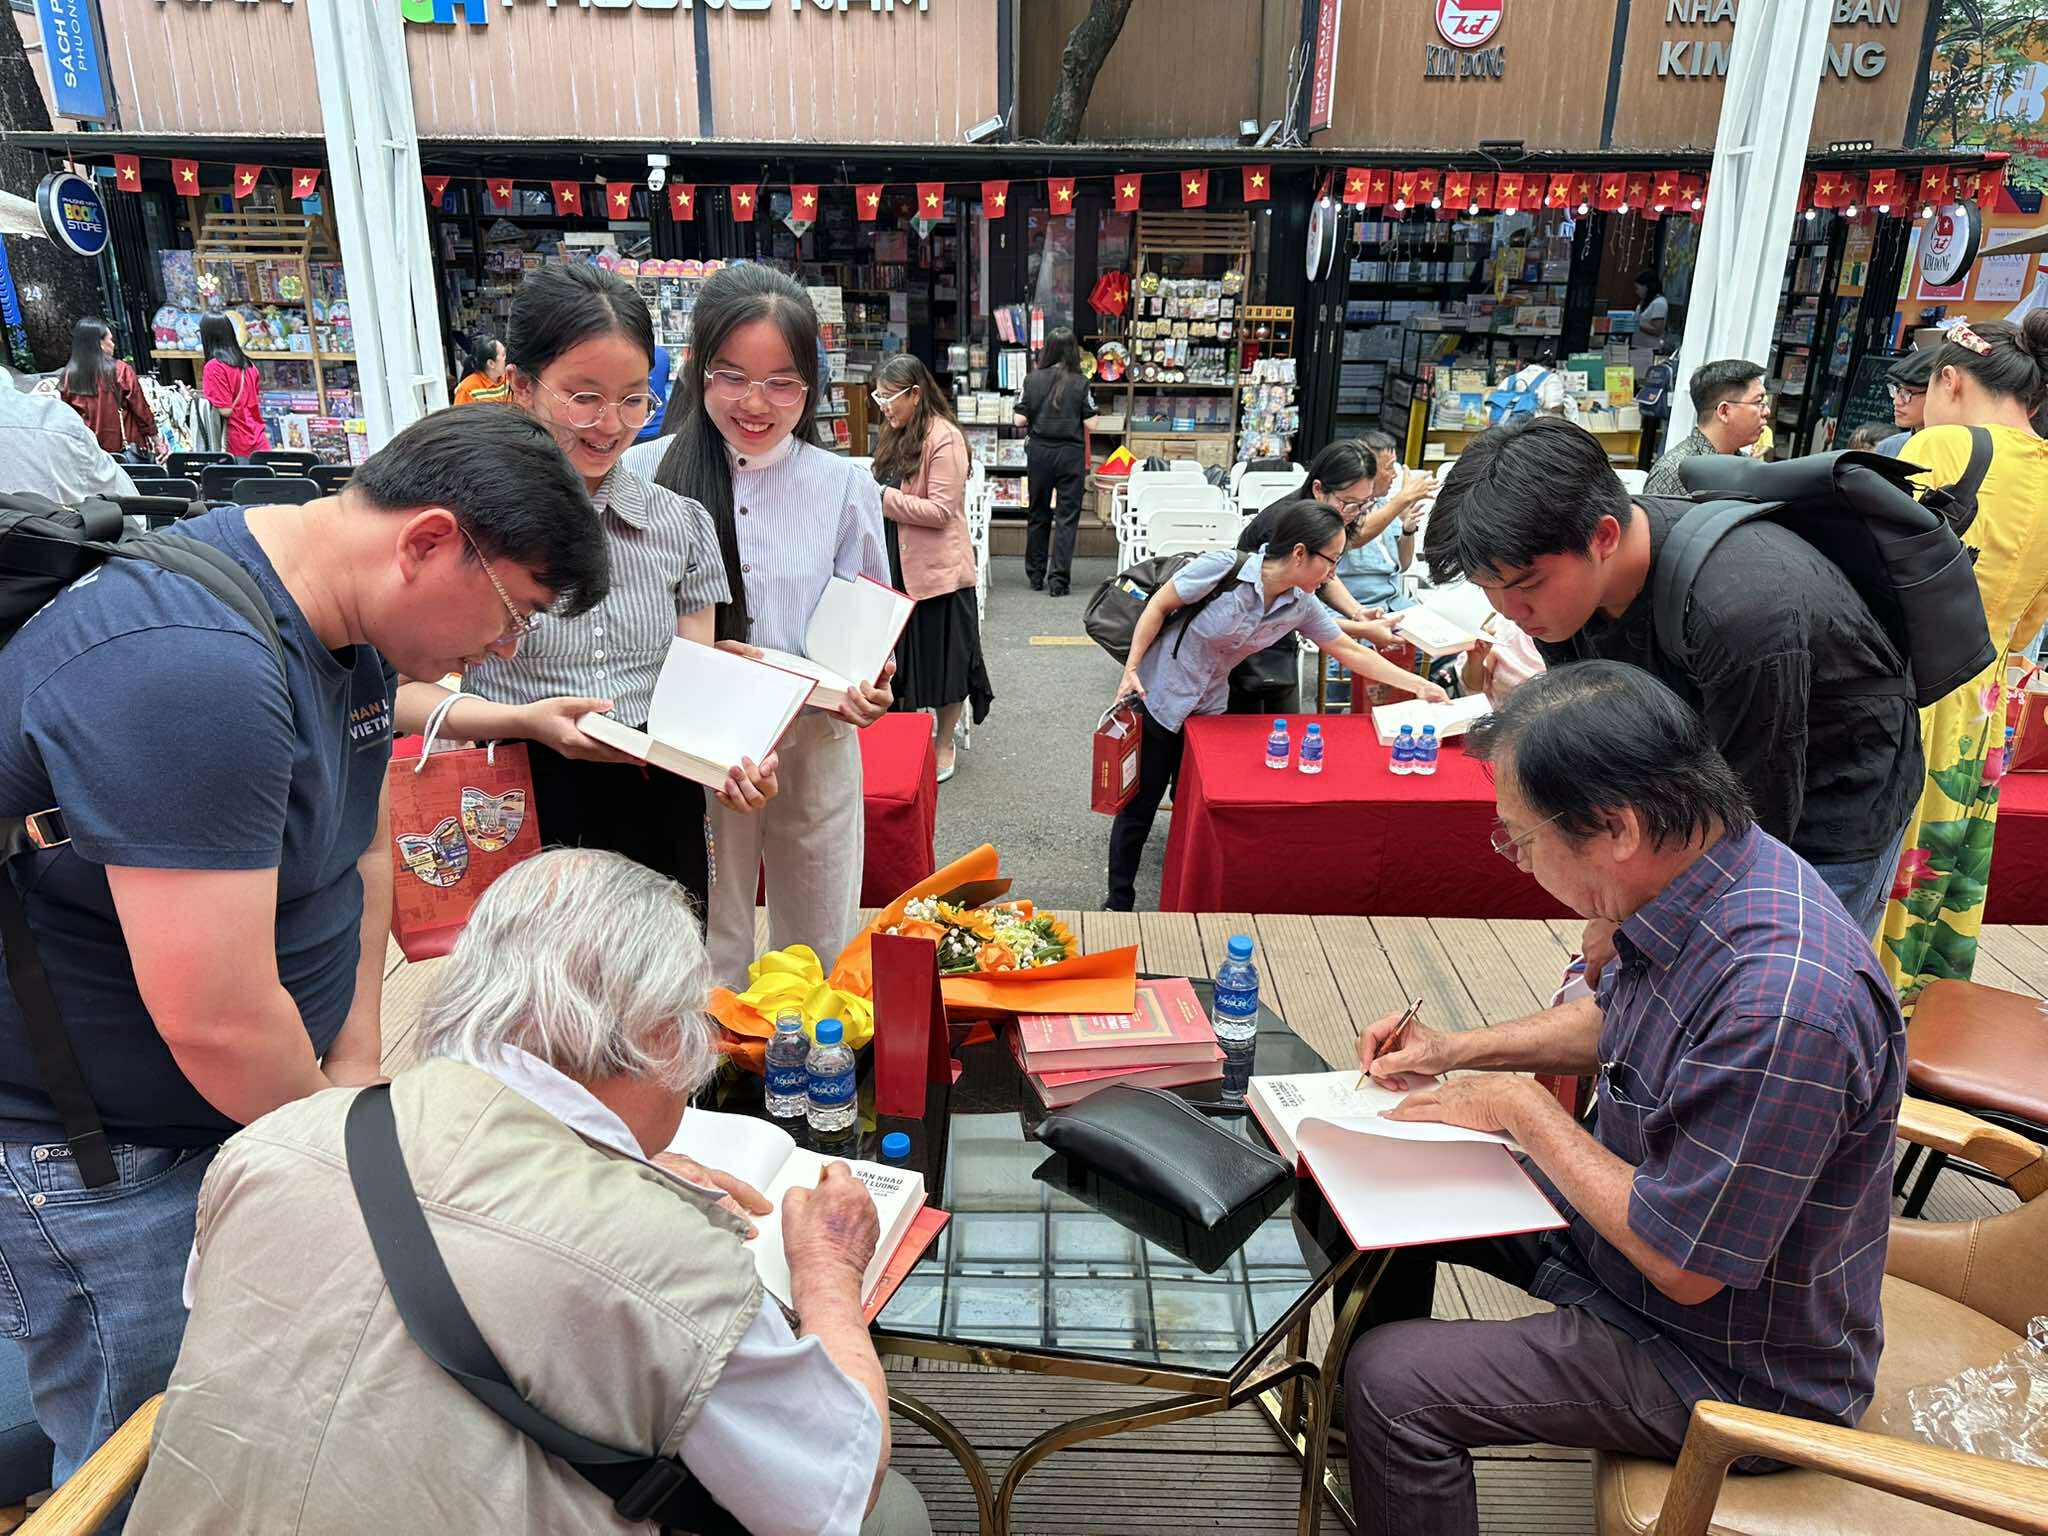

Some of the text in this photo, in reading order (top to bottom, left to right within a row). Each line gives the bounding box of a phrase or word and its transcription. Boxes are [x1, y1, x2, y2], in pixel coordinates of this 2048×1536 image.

[67, 0, 88, 71] PHUON
[1423, 42, 1459, 76] KIM
[1820, 41, 1886, 77] NG
[64, 203, 100, 222] BOOK
[67, 220, 103, 233] STORE
[349, 713, 389, 740] VIETN
[50, 1147, 73, 1157] Calv
